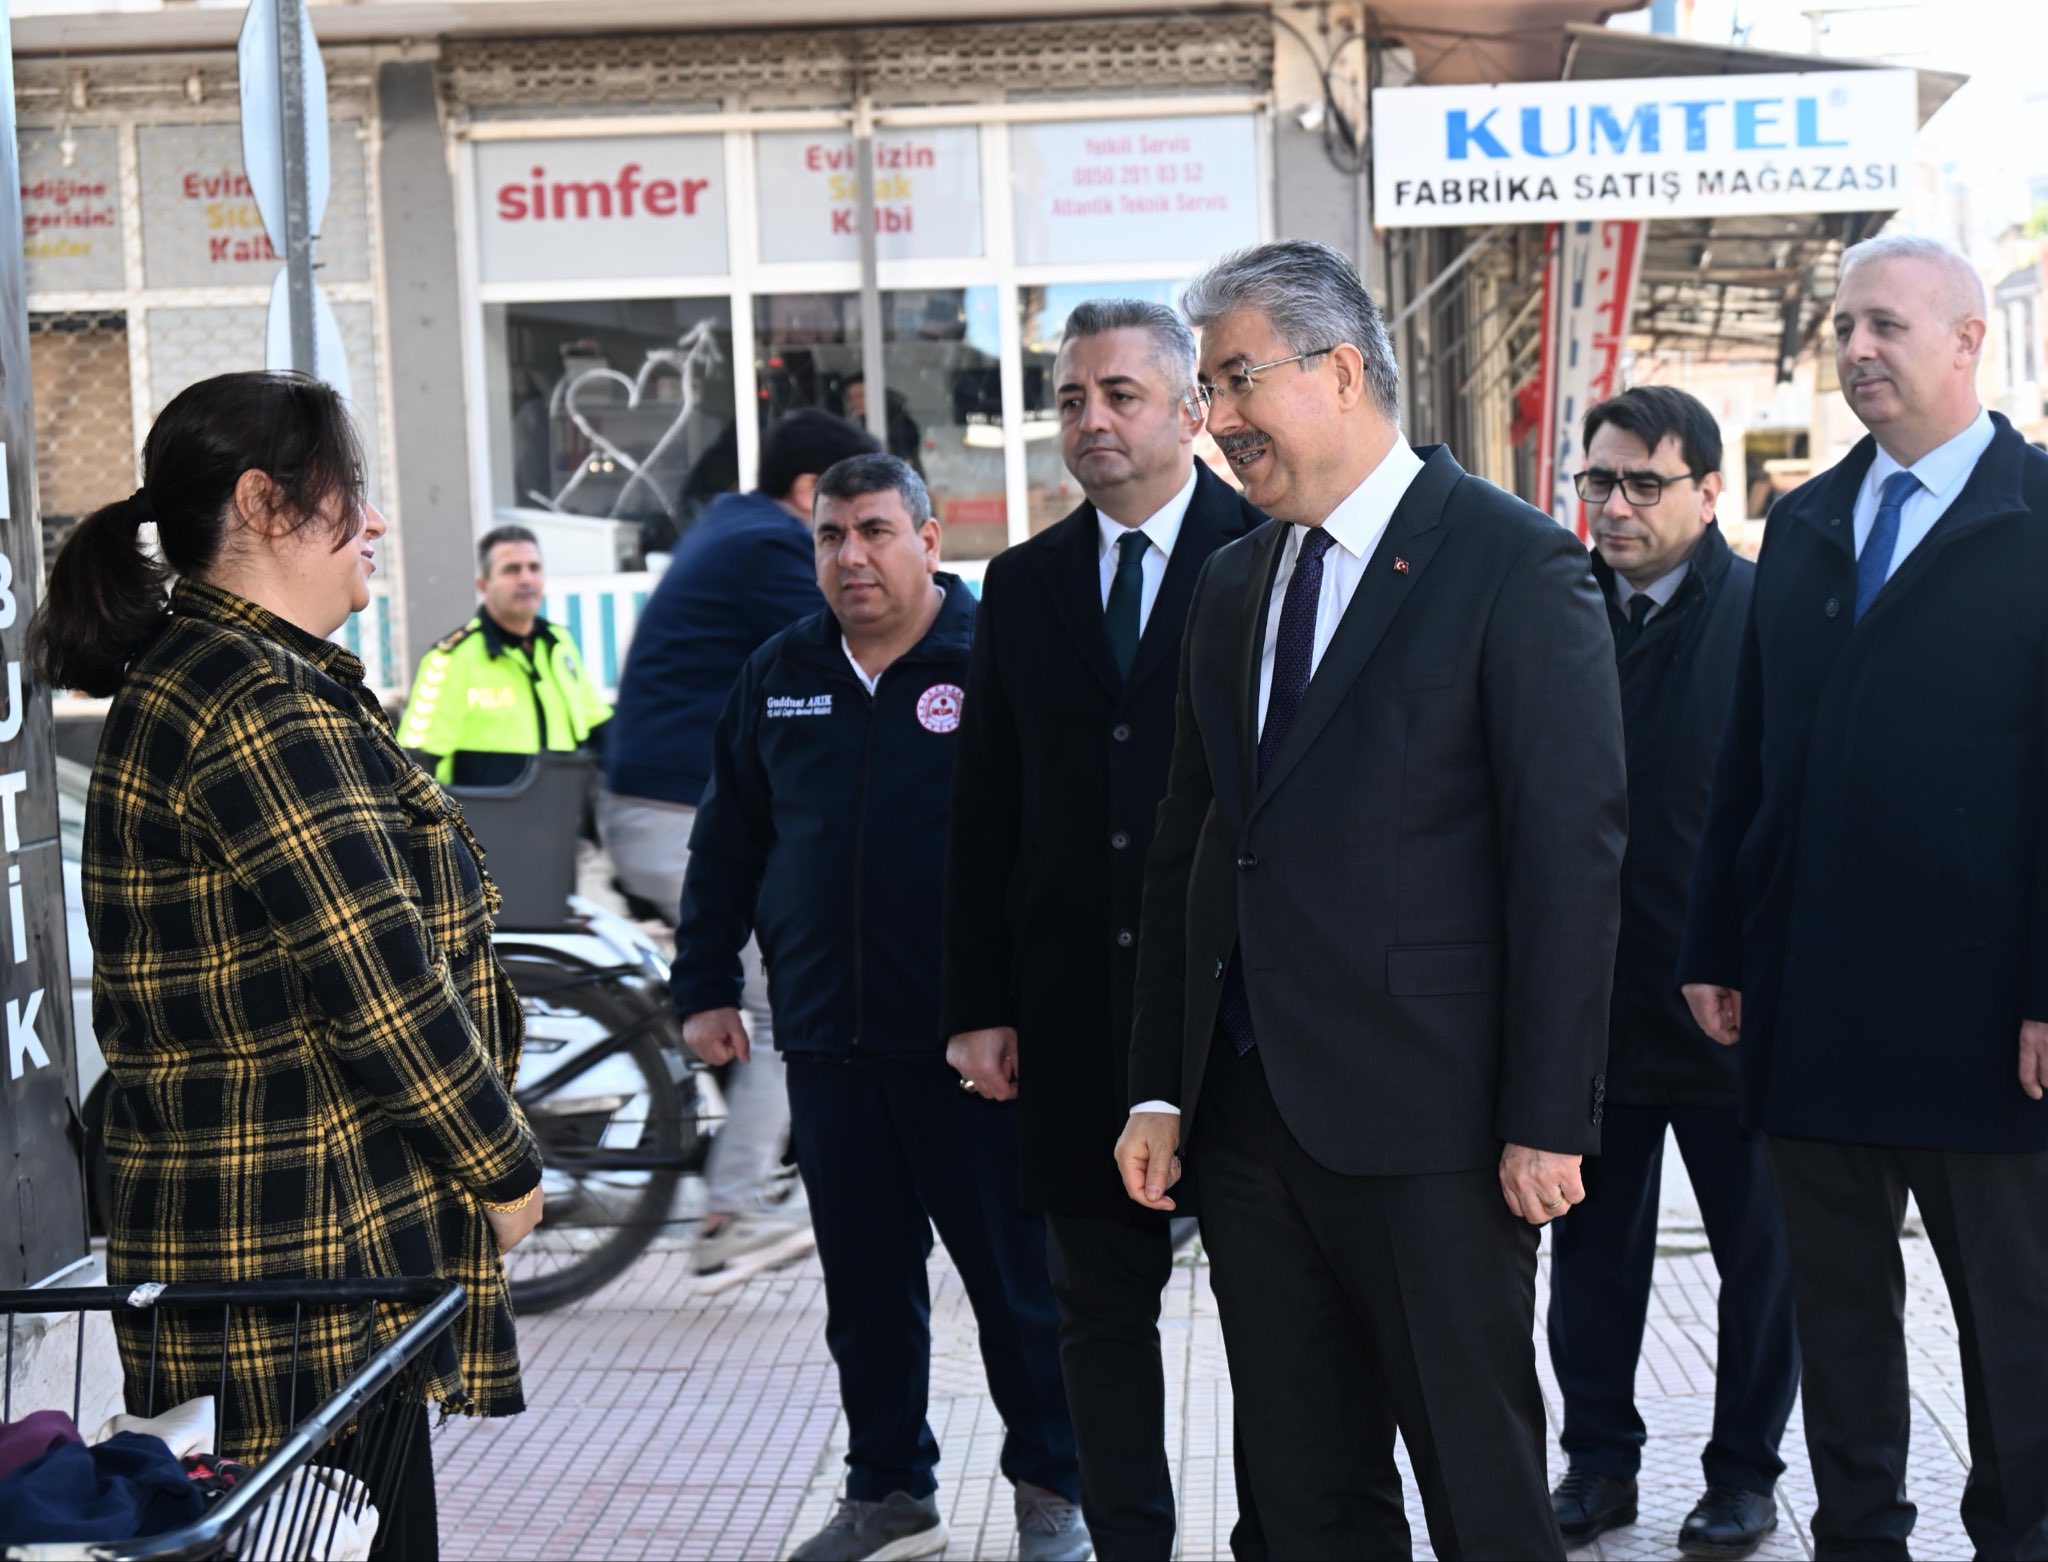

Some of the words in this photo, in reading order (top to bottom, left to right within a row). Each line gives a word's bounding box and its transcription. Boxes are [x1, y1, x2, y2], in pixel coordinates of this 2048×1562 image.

[1446, 97, 1850, 161] KUMTEL
[804, 143, 934, 171] Eviizin
[1139, 135, 1190, 153] Servis
[499, 164, 708, 221] simfer
[828, 174, 912, 201] Sıak
[1395, 171, 1558, 206] FABRİKA
[1573, 169, 1681, 203] SATIŞ
[1697, 161, 1897, 195] MAĞAZASI
[1176, 192, 1226, 210] Servis
[831, 206, 912, 234] Klbi
